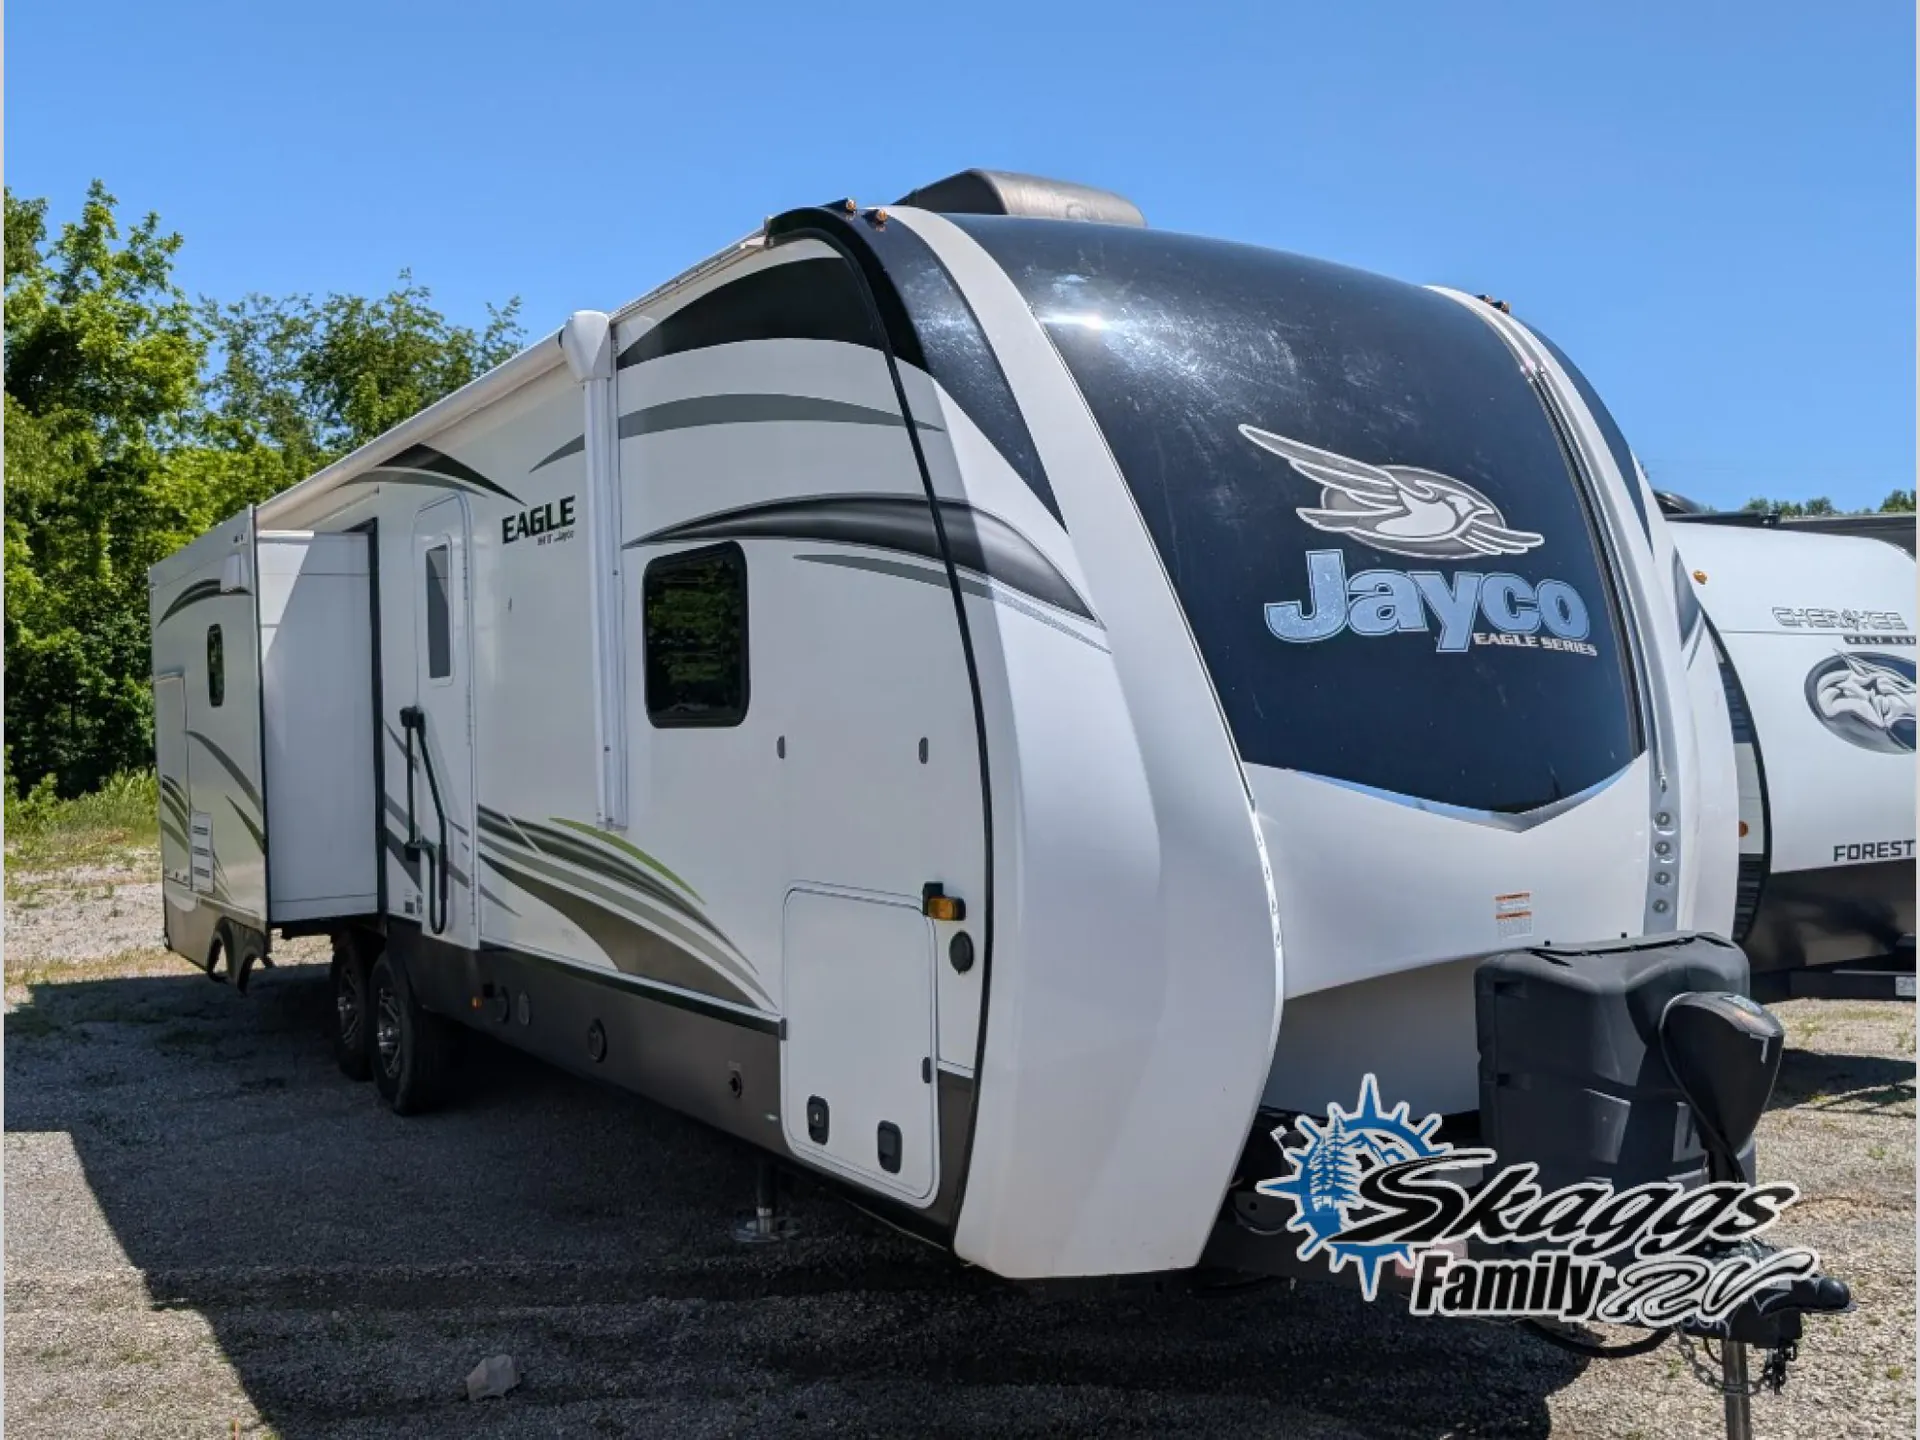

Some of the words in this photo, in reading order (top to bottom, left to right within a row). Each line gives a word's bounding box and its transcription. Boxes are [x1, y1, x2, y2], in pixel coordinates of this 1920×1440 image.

[502, 495, 576, 545] EAGLE
[1264, 549, 1591, 653] Jayco
[1473, 632, 1540, 648] EAGLE
[1540, 636, 1599, 657] SERIES
[1833, 839, 1916, 871] FOREST
